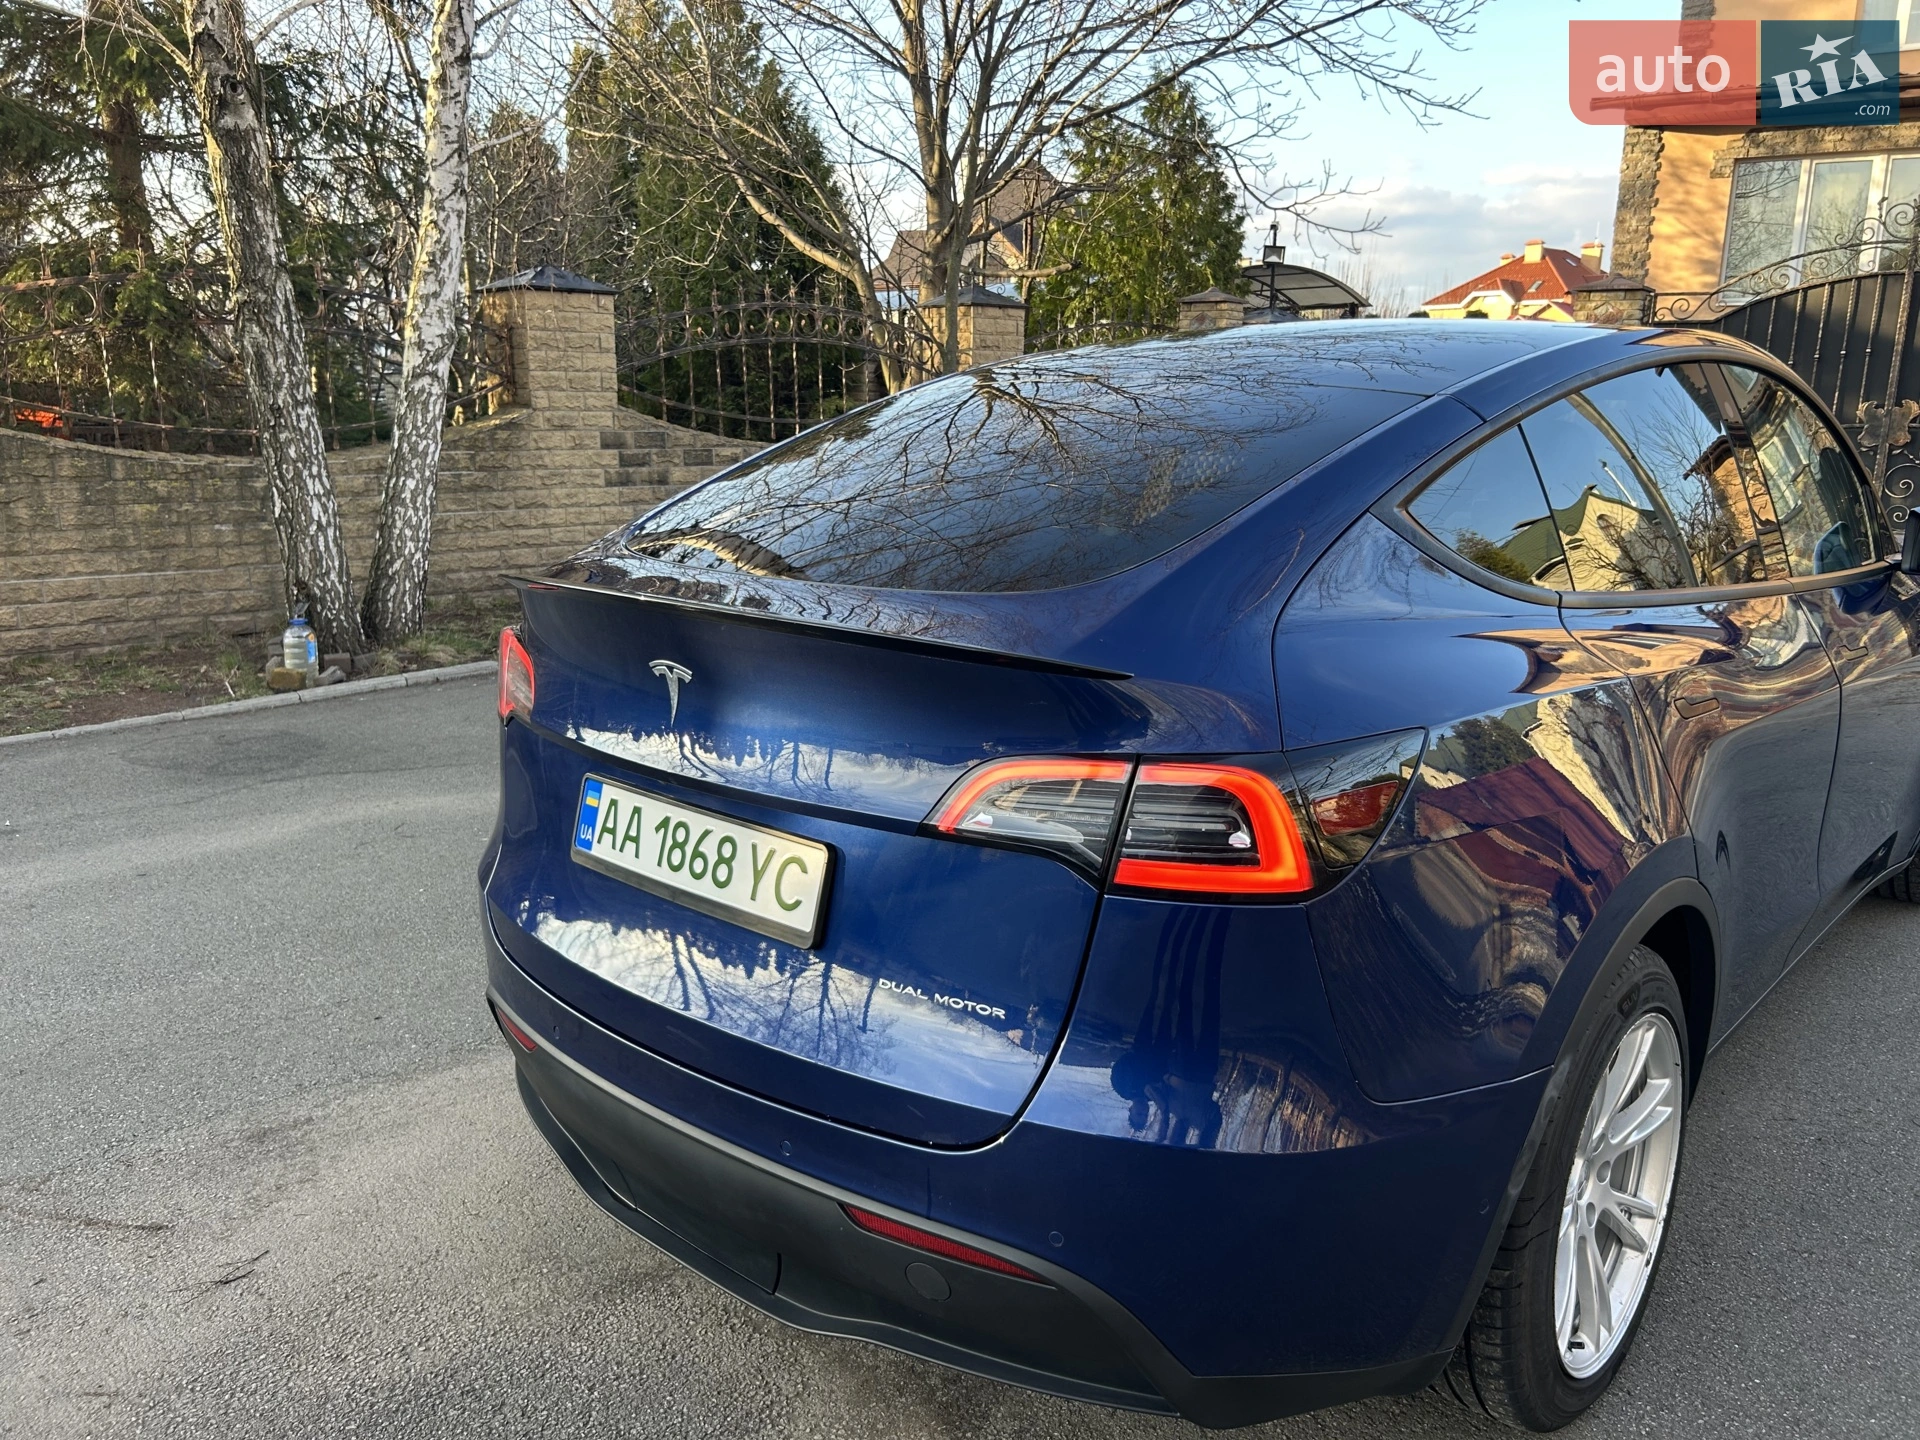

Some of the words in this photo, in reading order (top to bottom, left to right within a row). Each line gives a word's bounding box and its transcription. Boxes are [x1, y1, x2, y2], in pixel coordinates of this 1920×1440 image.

[580, 823, 593, 842] UA
[597, 797, 642, 859] AA
[654, 814, 738, 889] 1868
[750, 842, 808, 911] YC
[878, 977, 929, 1000] DUAL
[934, 993, 1006, 1019] MOTOR
